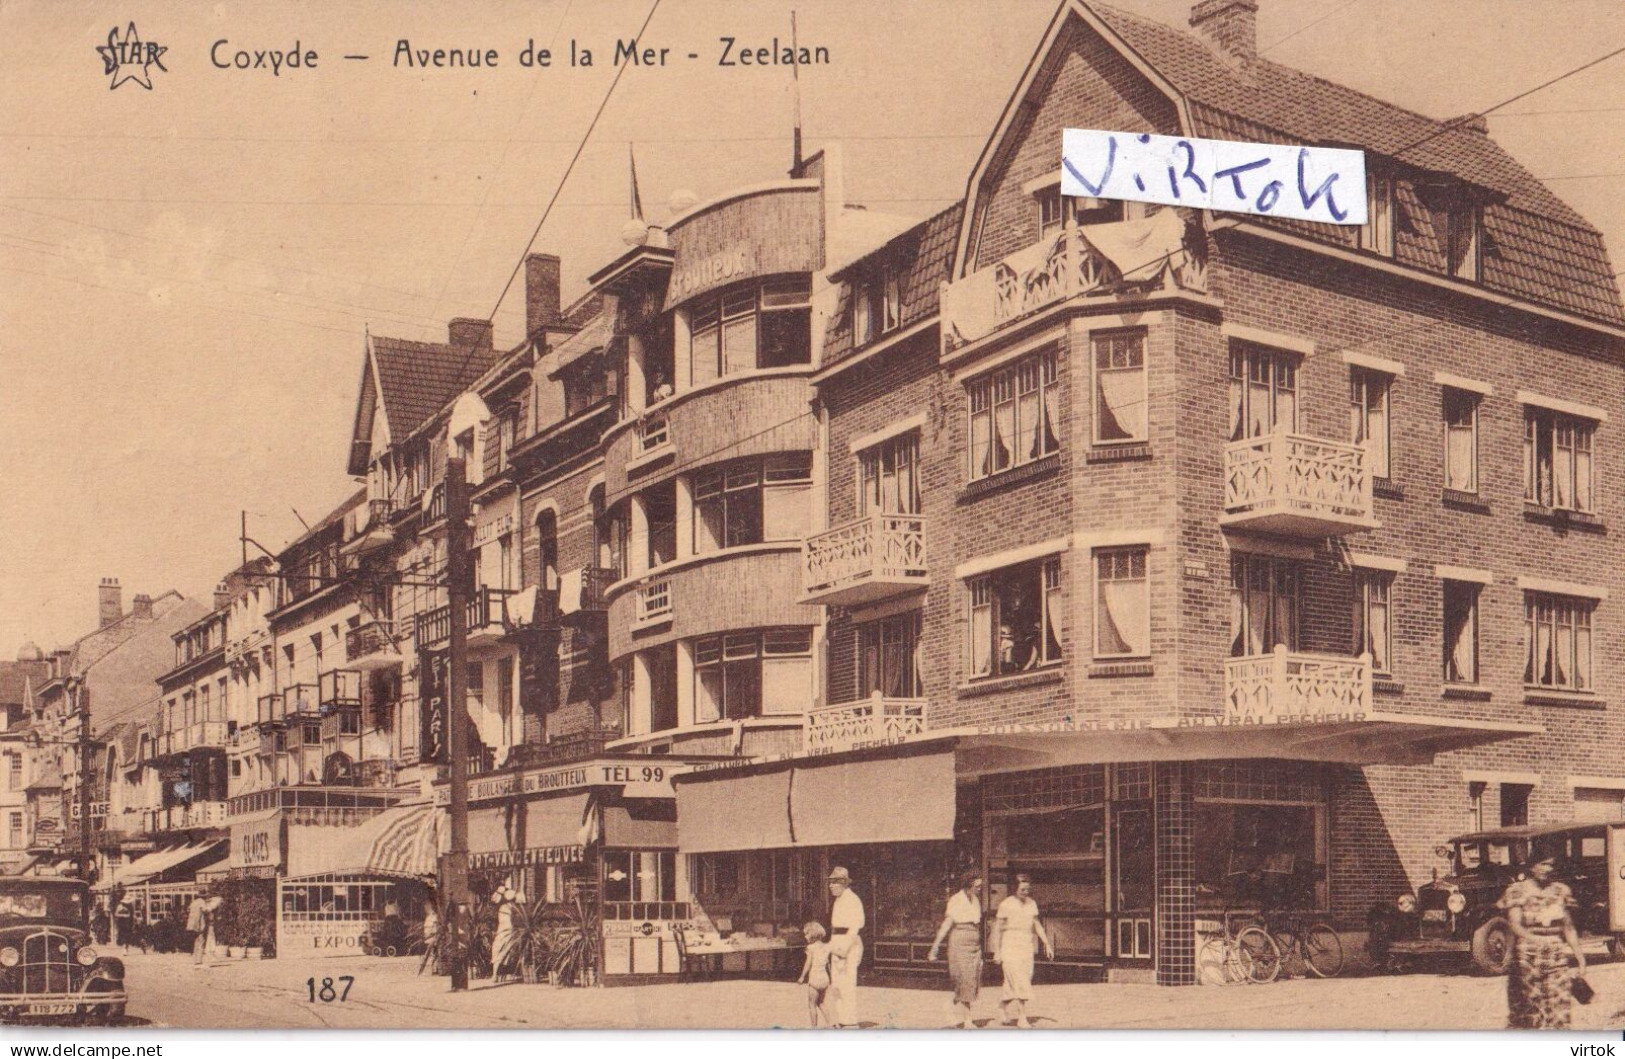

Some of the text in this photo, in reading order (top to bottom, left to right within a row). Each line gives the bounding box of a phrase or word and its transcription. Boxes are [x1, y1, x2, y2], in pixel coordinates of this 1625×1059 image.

[103, 26, 168, 75] STAR
[210, 39, 319, 76] Coxyde
[393, 39, 499, 68] Avenue
[519, 38, 553, 67] de
[571, 39, 594, 67] la
[613, 38, 671, 67] Mer
[718, 37, 831, 66] Zeelaan
[1178, 717, 1206, 728] AU
[1214, 715, 1264, 727] VRAI
[538, 768, 588, 790] BROUTTEUX
[642, 767, 664, 783] 99
[72, 803, 111, 816] GAGE
[306, 976, 355, 1003] 187
